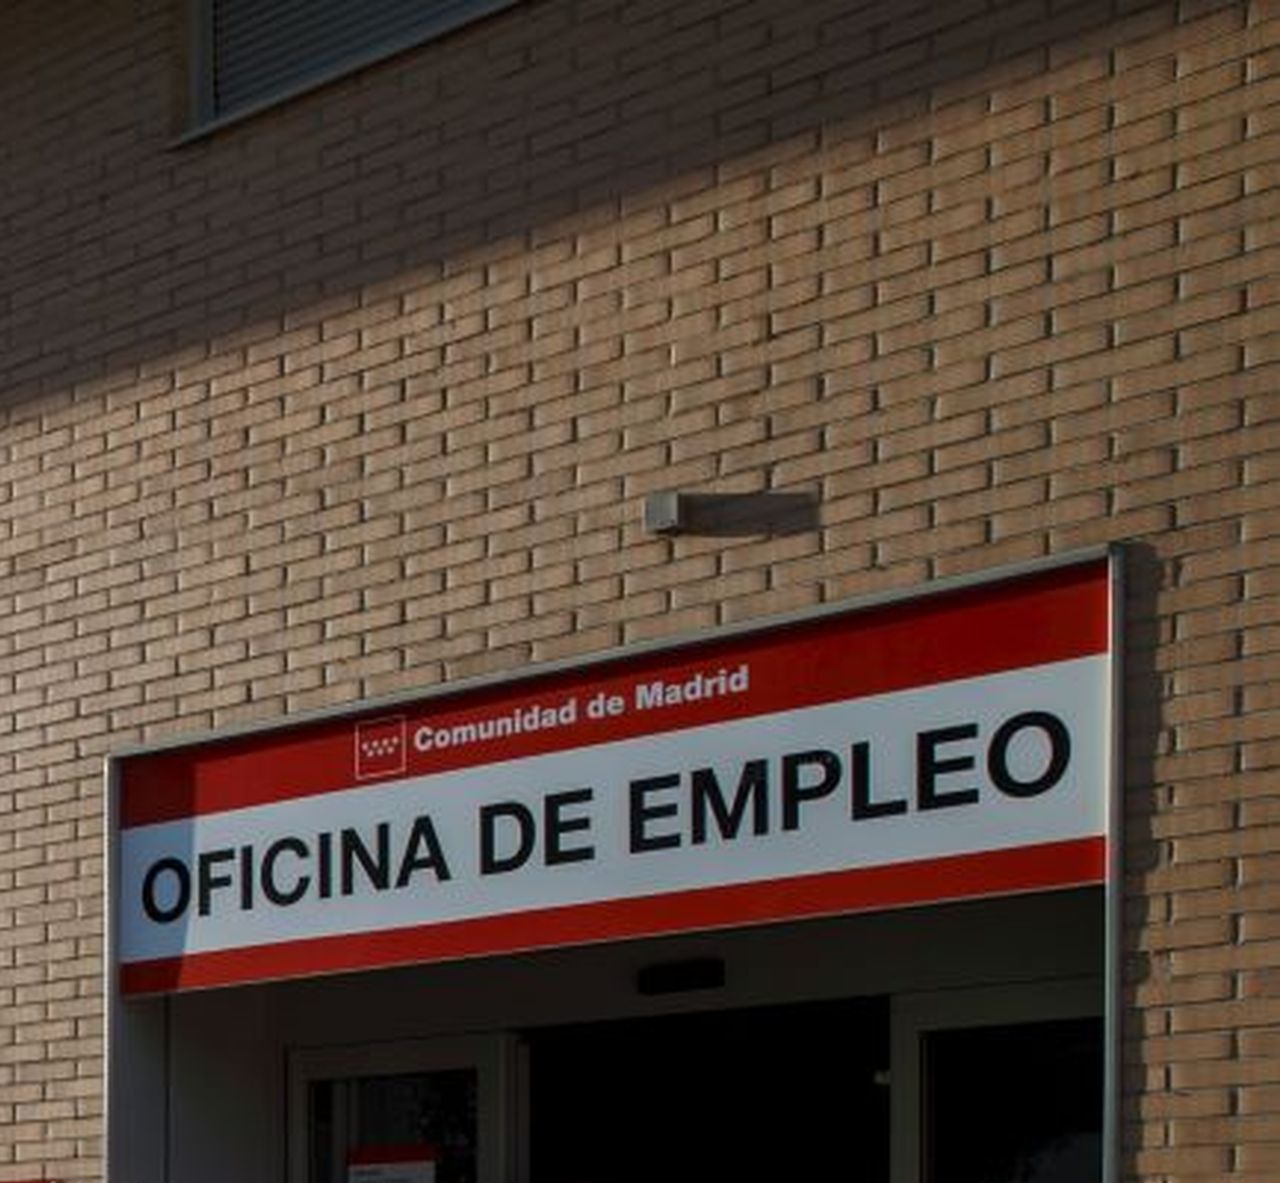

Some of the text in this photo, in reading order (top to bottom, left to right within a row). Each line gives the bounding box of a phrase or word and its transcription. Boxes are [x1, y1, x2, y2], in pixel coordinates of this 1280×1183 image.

[413, 664, 750, 753] Comunidad de Madrid
[141, 710, 1072, 925] OFICINA DE EMPLEO
